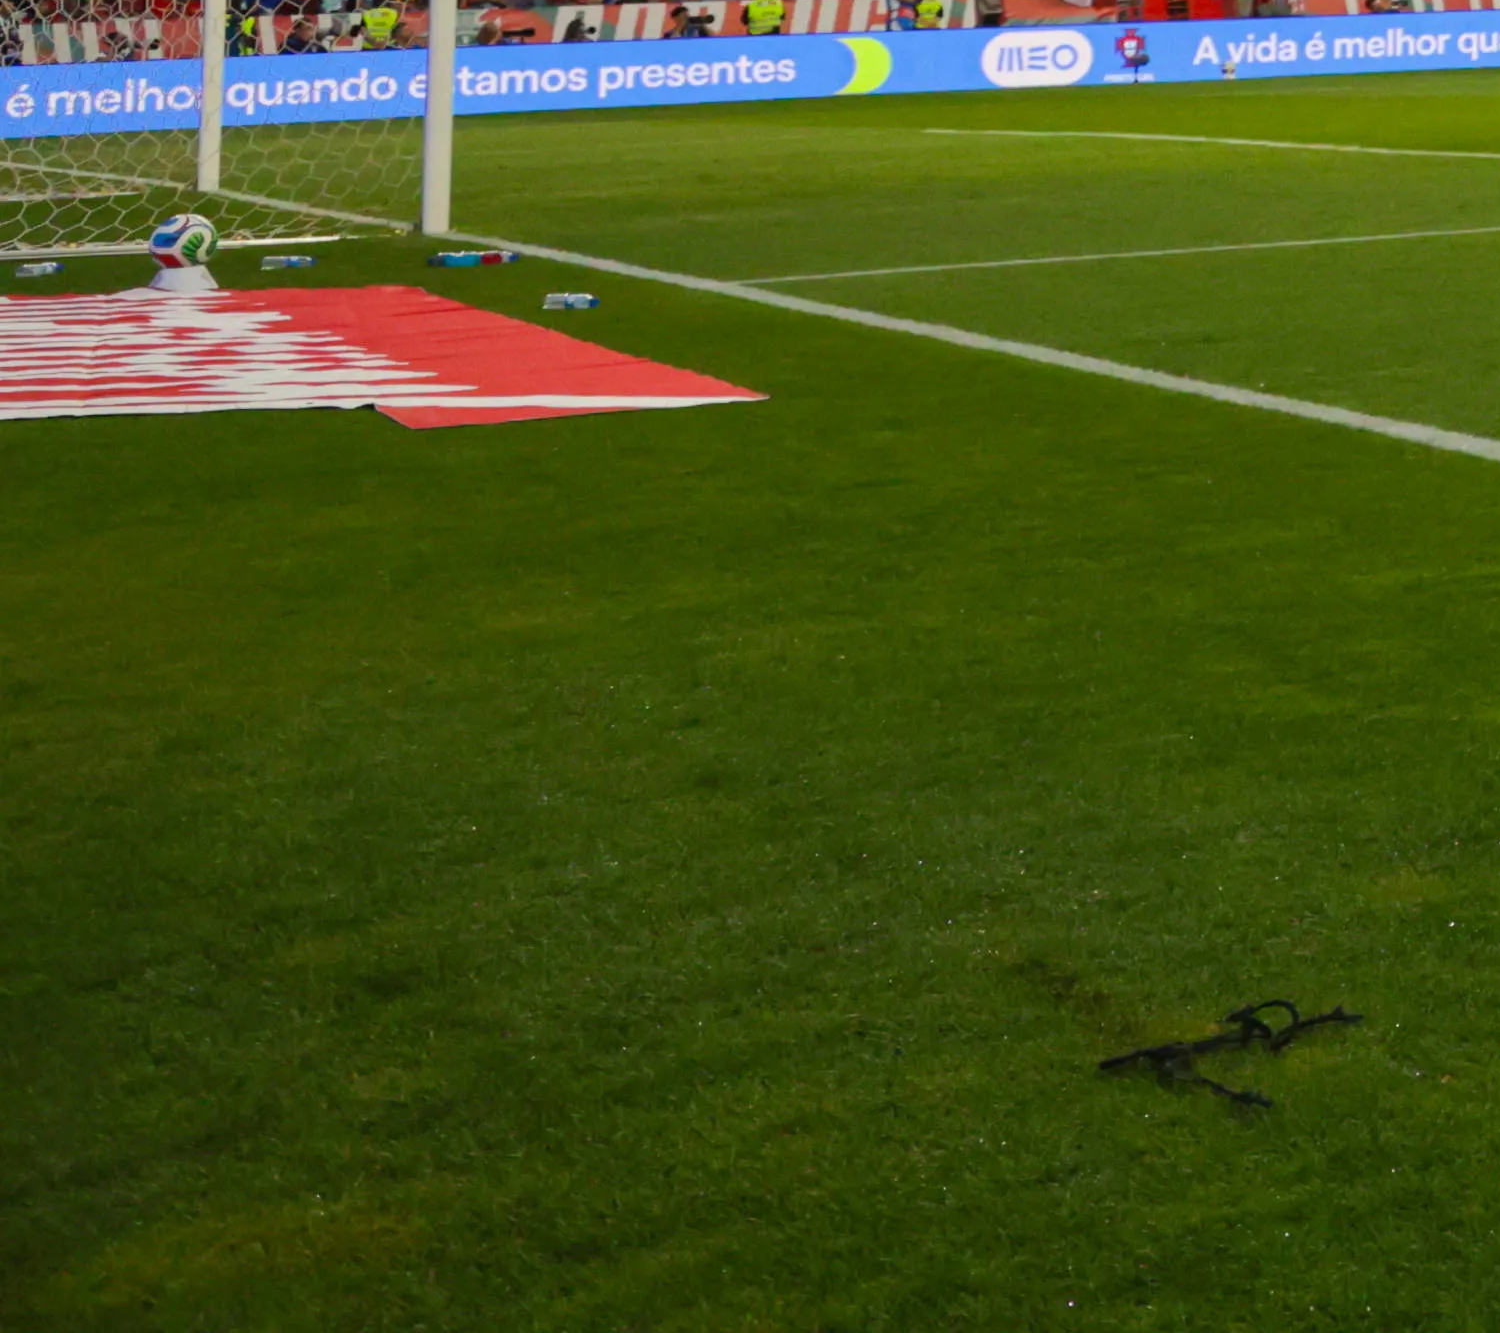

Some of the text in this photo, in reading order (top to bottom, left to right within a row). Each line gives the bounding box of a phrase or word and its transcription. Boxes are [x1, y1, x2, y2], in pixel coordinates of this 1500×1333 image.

[998, 45, 1078, 72] MEO
[1193, 36, 1221, 65] A
[1227, 34, 1298, 63] vida
[1305, 31, 1325, 61] é
[1333, 27, 1449, 60] melhor
[6, 55, 796, 118] é melho quando etamos presentes
